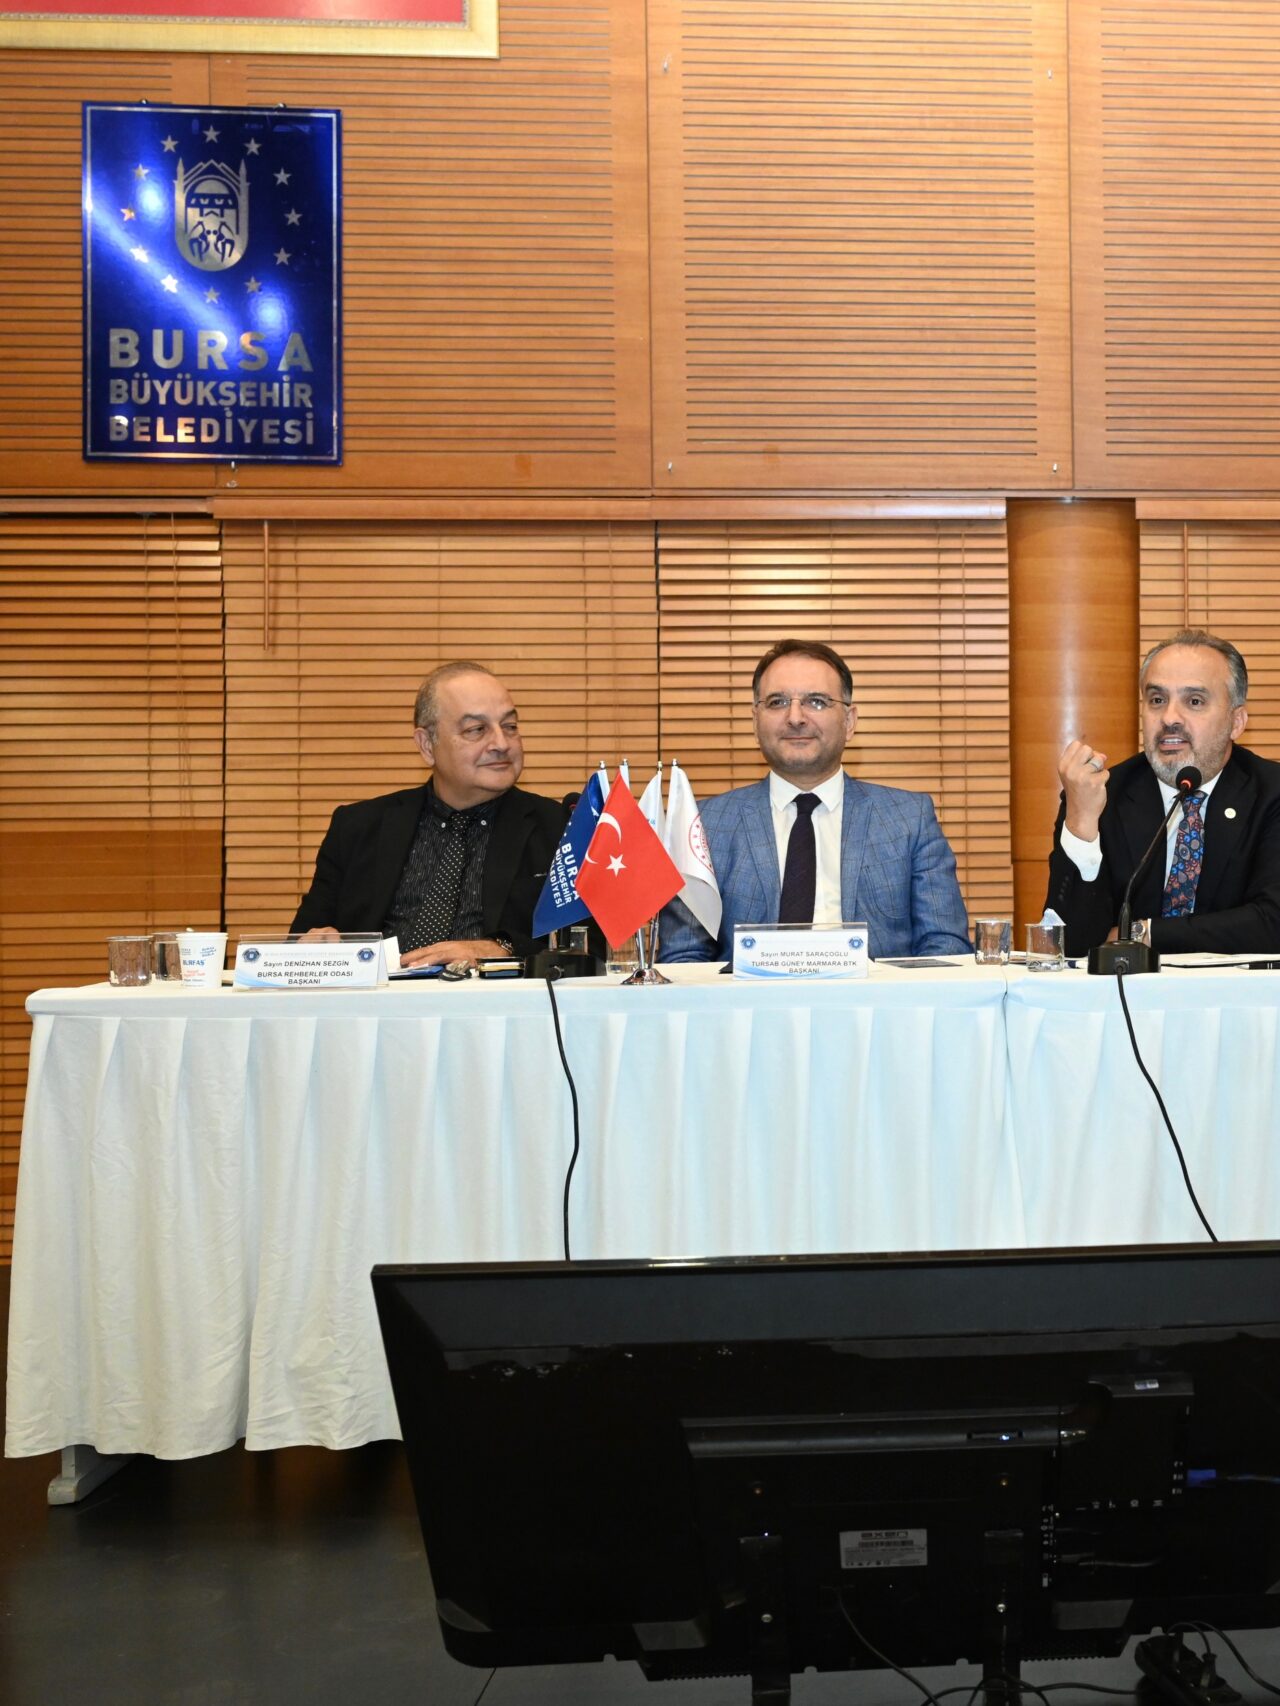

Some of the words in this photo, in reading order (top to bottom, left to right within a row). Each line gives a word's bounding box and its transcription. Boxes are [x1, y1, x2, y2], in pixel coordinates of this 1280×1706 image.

[109, 328, 314, 372] BURSA
[109, 373, 313, 411] BÜYÜKŞEHİR
[109, 411, 314, 445] BELEDİYESİ
